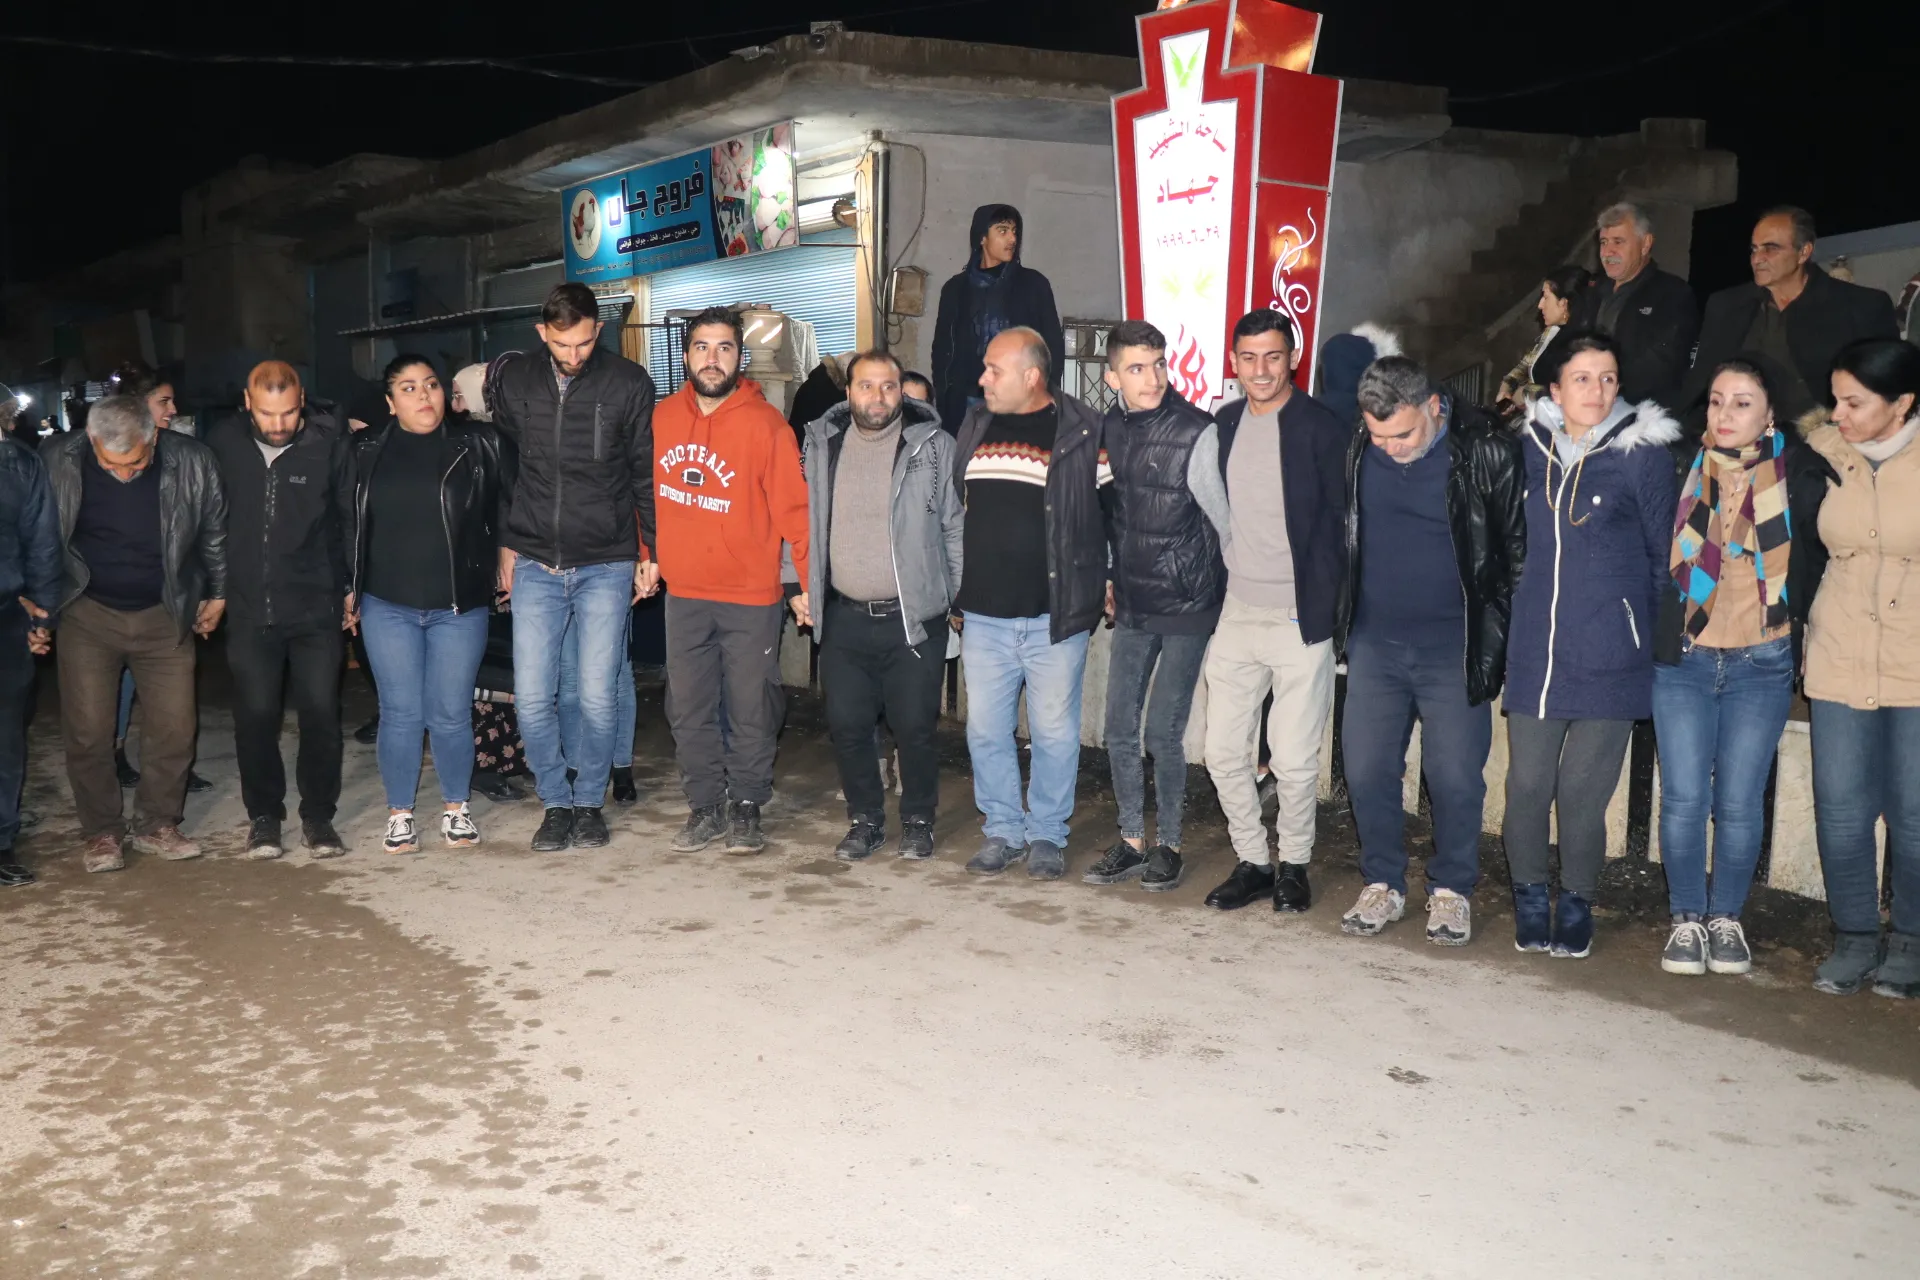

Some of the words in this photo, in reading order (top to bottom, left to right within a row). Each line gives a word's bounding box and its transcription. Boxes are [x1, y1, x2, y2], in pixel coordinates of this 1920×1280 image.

[1149, 118, 1189, 159] الشهيد
[1195, 113, 1227, 152] ساحة
[653, 159, 704, 217] فروج
[1156, 175, 1219, 204] جهاد
[659, 443, 736, 488] FOOTBALL
[659, 483, 686, 505] DIVISION
[697, 494, 731, 514] VARSITY
